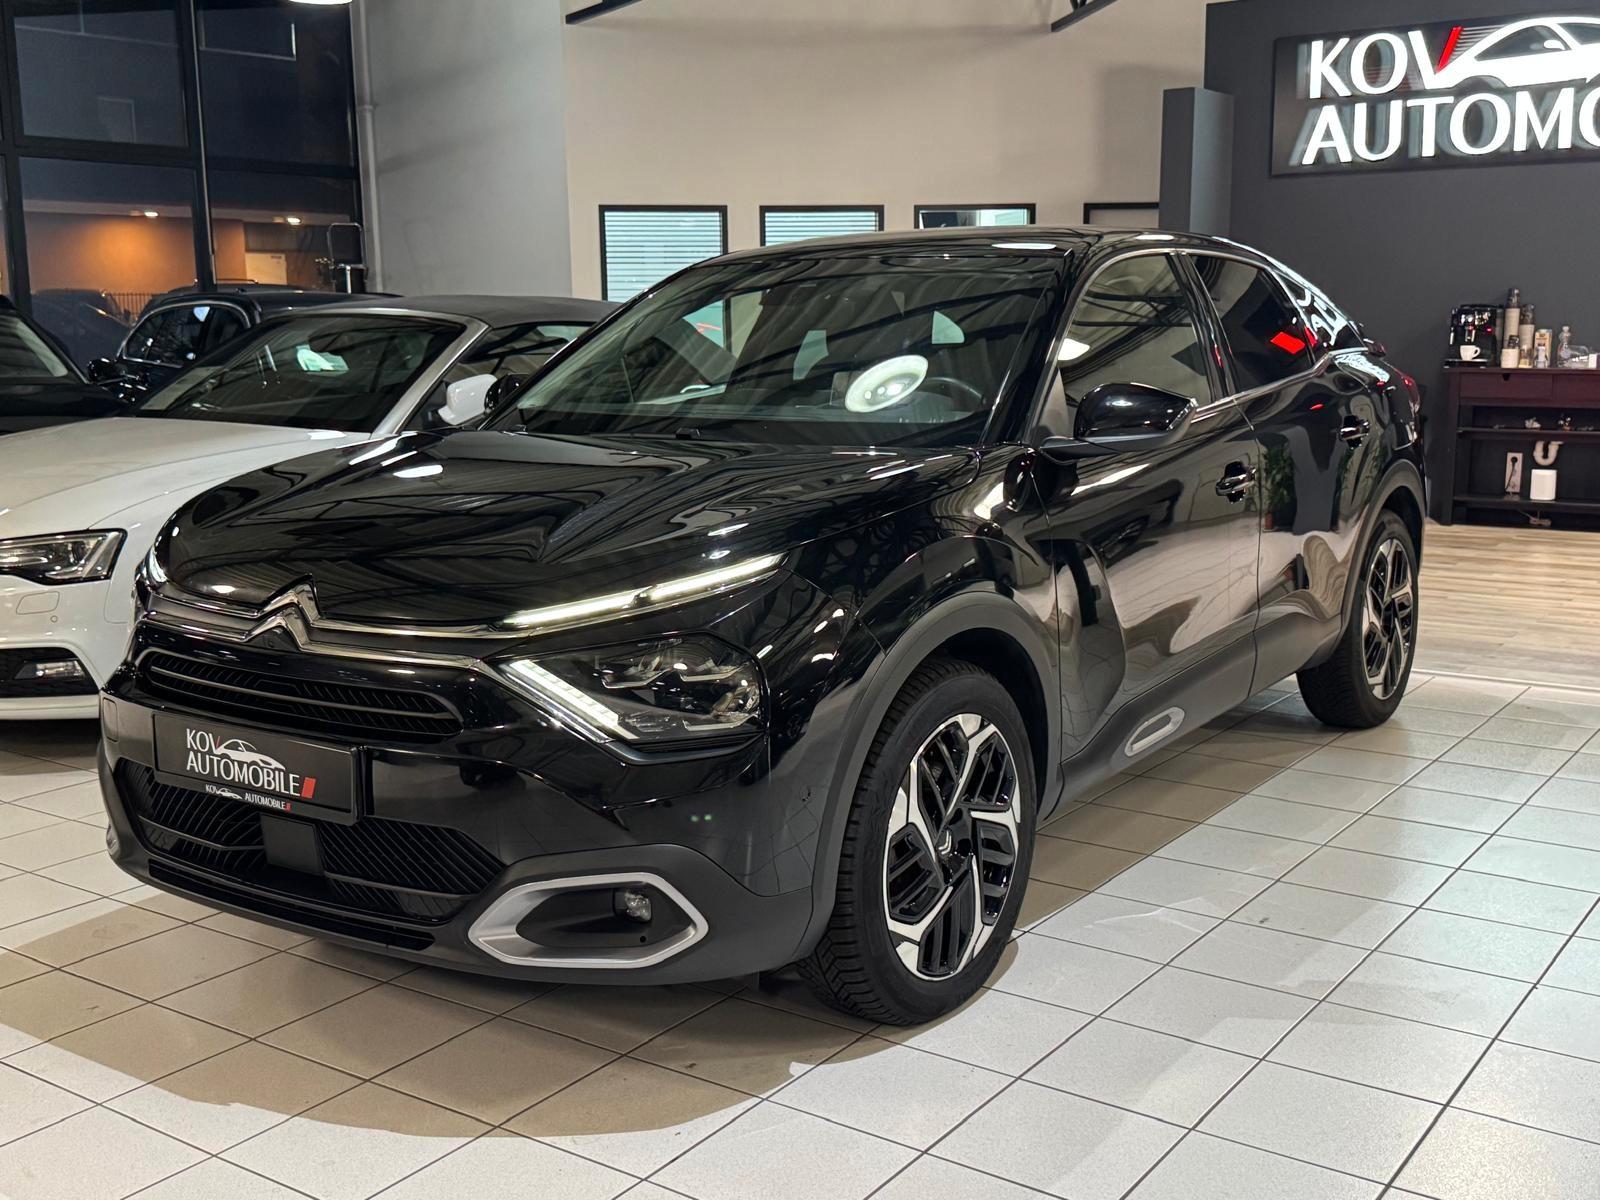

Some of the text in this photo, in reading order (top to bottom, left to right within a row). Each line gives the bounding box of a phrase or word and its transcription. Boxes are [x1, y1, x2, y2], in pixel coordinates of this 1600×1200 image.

[1309, 26, 1464, 99] KOV
[186, 728, 221, 755] KOV
[186, 751, 300, 797] AUTOMOBILE
[244, 792, 286, 811] AUTOMOBILE
